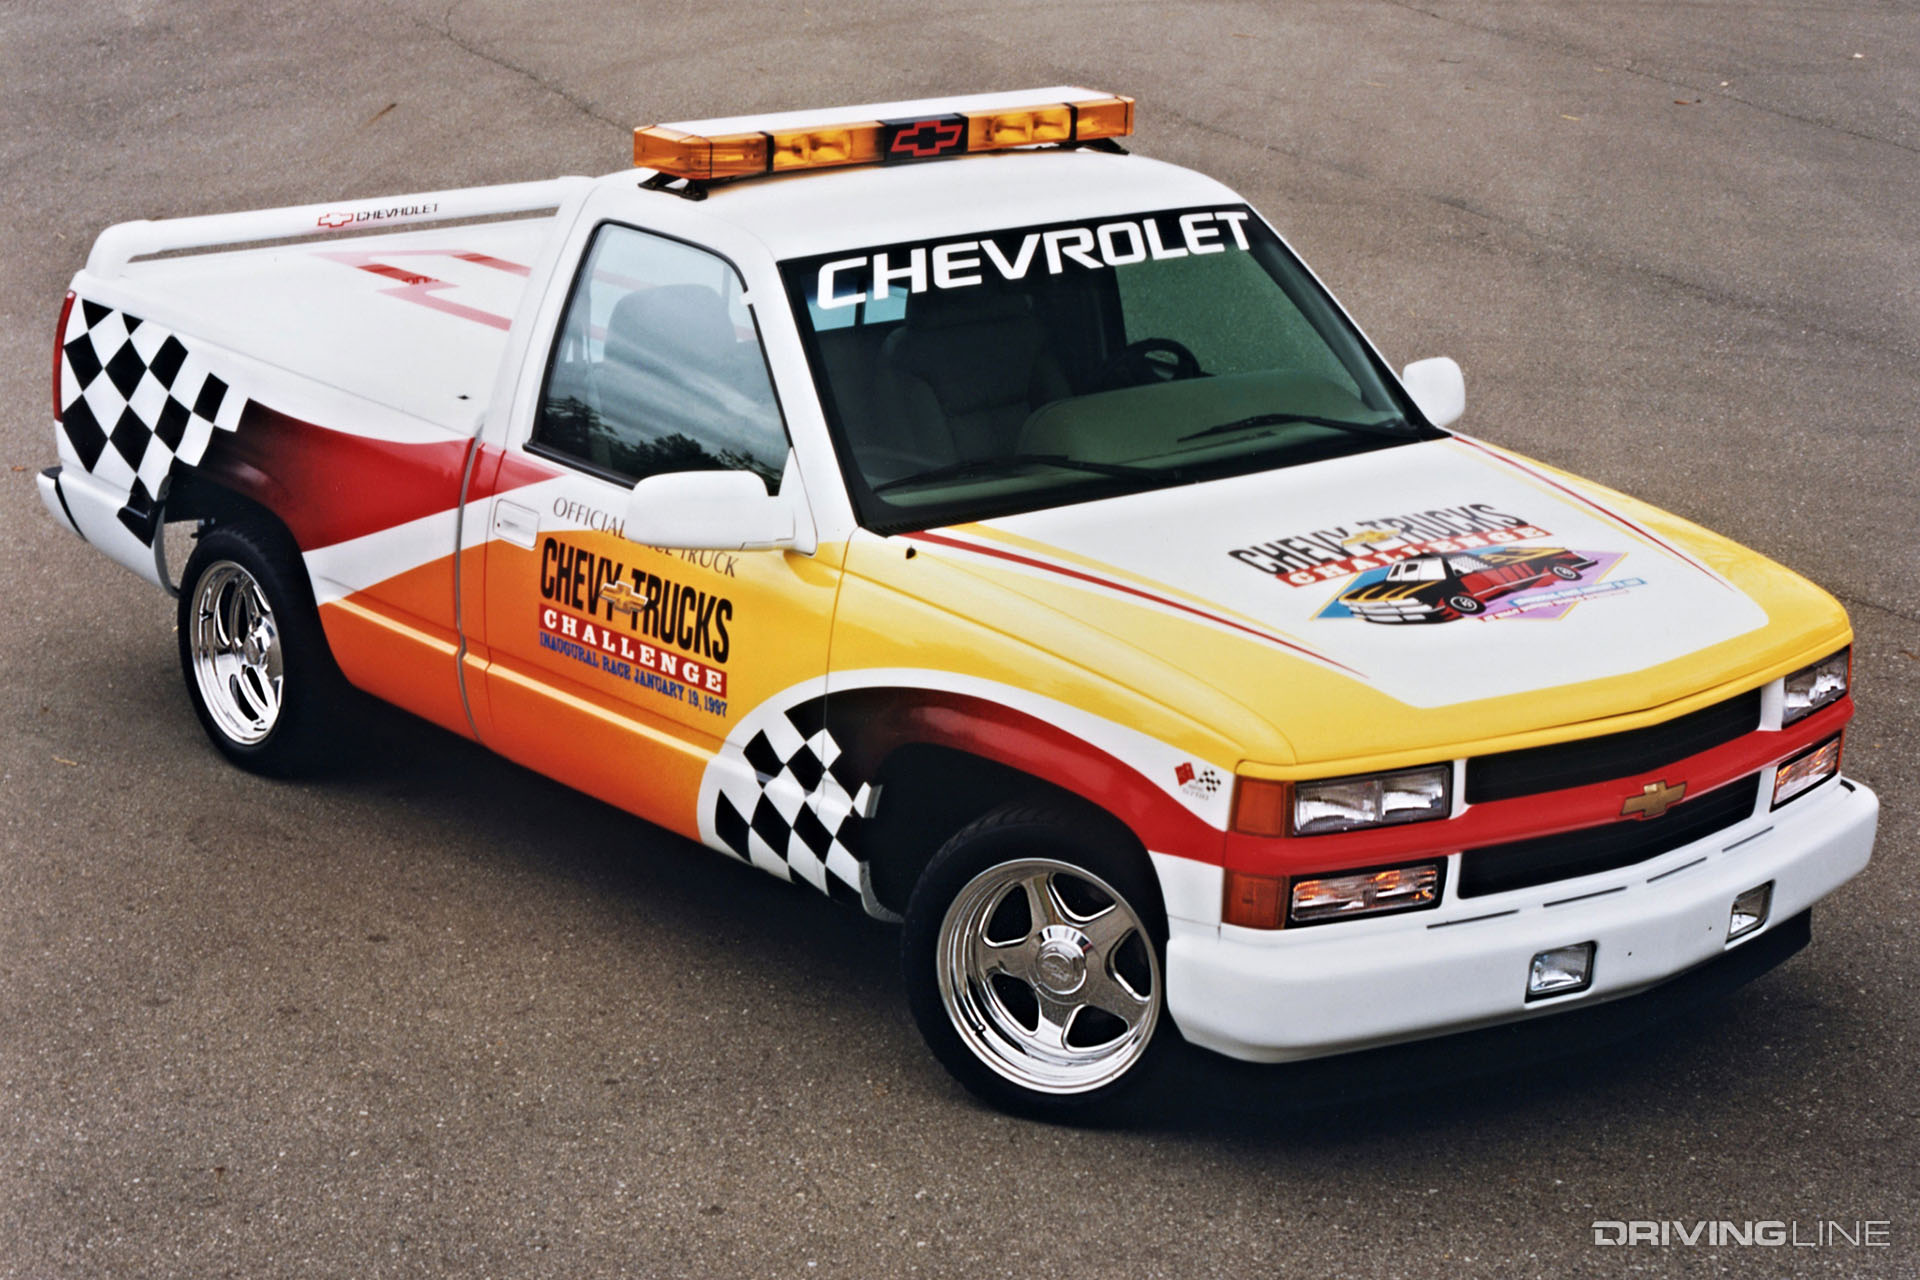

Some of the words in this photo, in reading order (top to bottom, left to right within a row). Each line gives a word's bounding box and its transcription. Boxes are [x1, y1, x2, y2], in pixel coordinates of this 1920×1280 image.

[356, 203, 439, 222] CHEVROLET
[817, 210, 1249, 310] CHEVROLET
[553, 496, 627, 540] OFFICIAL
[1228, 527, 1384, 575] CHEVY
[1356, 504, 1529, 545] TRUCKS
[540, 537, 624, 621] CHEVY
[630, 568, 733, 664] TRUCKS
[539, 630, 600, 668] INAUGURAL
[602, 655, 632, 680] RACE
[634, 668, 685, 701] JANUARY
[704, 693, 728, 718] 1997
[543, 608, 722, 694] CHALLENGE
